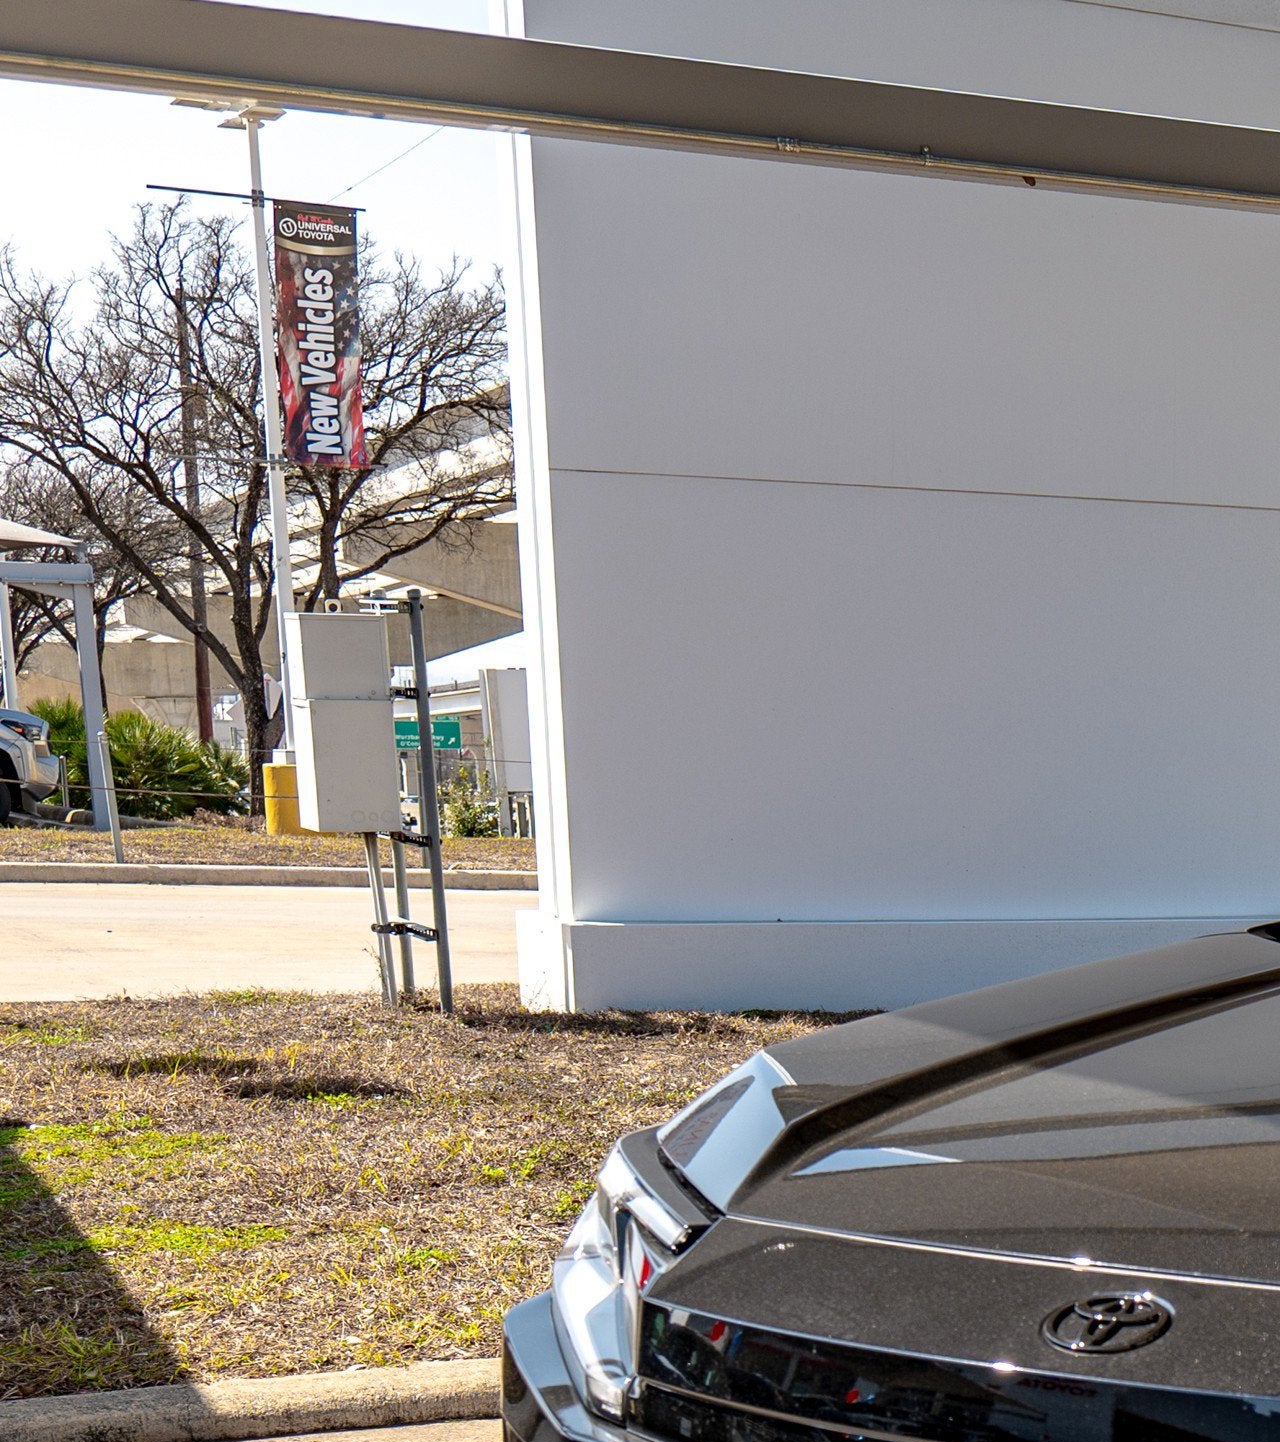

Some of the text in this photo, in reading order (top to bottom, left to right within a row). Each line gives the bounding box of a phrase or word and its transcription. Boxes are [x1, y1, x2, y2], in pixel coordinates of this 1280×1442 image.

[298, 220, 352, 235] UNIVERSAL
[298, 230, 335, 242] TOYOTA
[296, 266, 344, 456] New Vehicles
